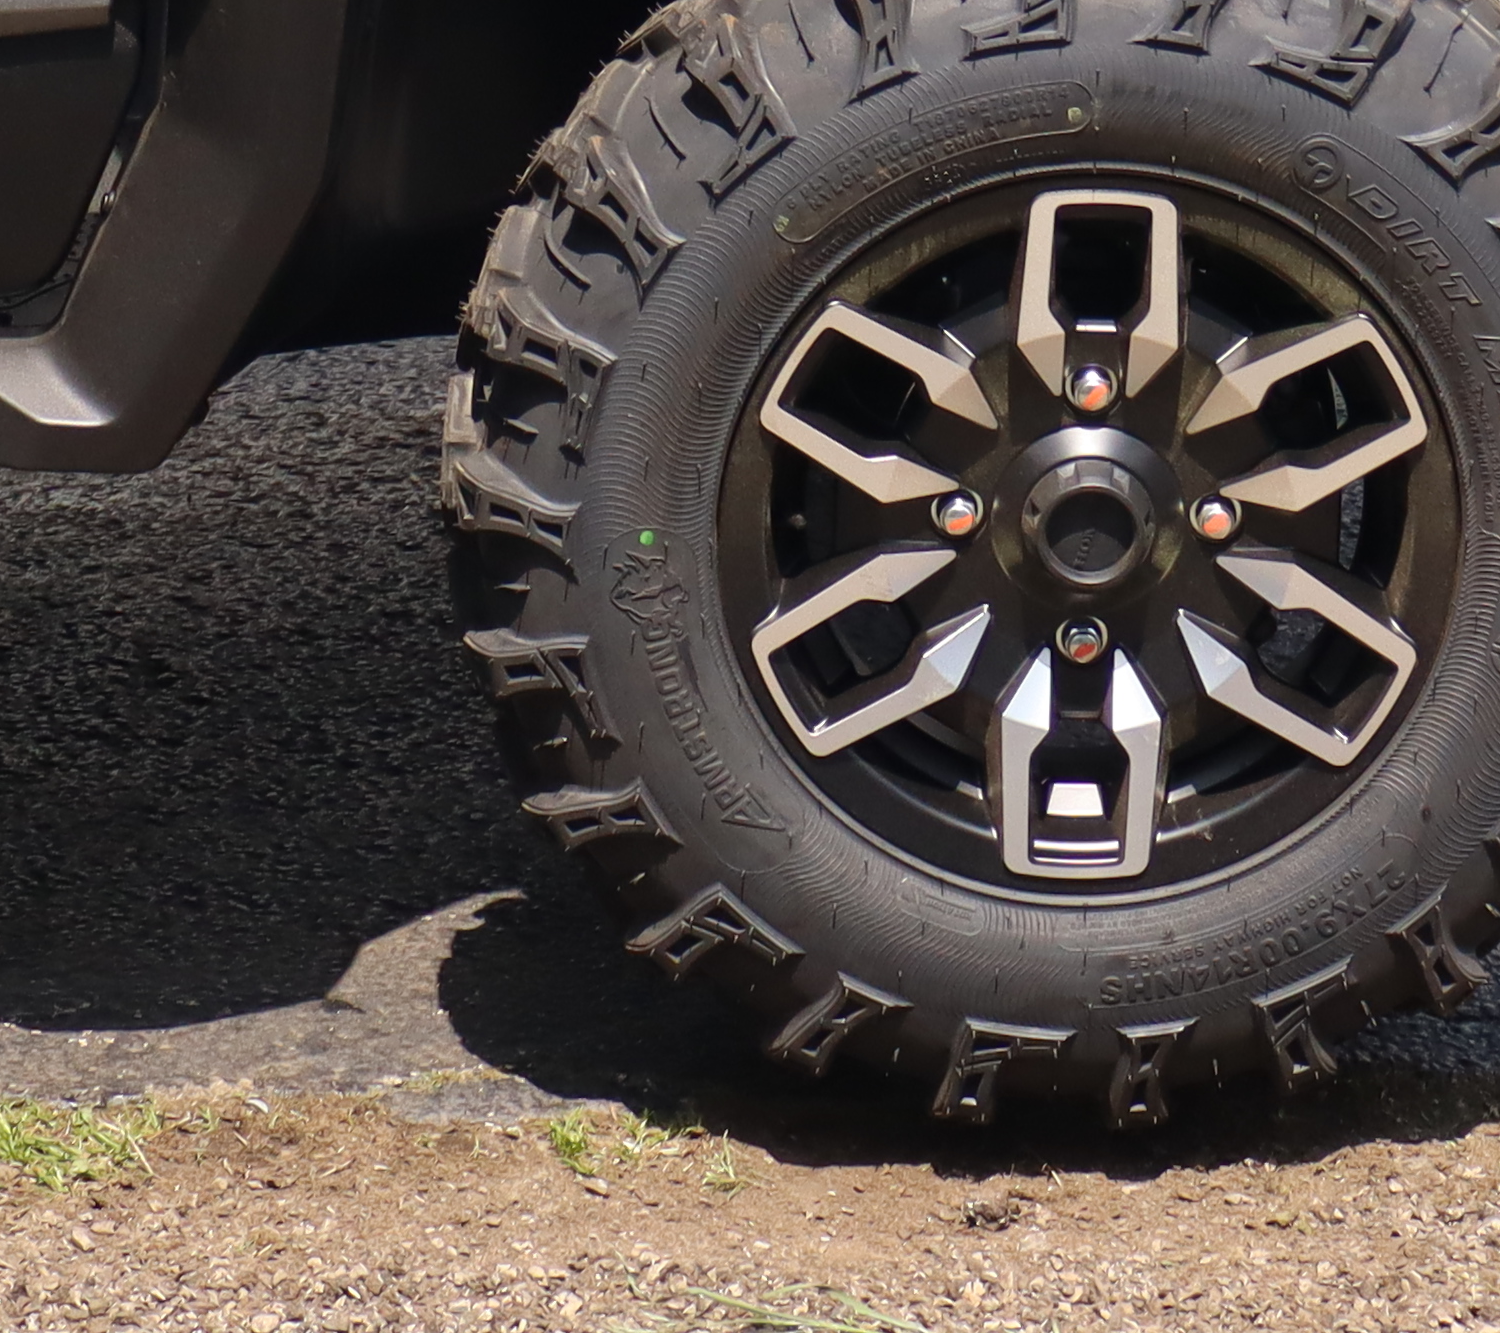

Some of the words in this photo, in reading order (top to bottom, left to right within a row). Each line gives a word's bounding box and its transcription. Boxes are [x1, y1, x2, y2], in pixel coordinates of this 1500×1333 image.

[860, 155, 913, 195] MADE
[914, 145, 938, 166] IN
[940, 124, 1001, 156] CHINA
[1347, 184, 1483, 306] DIRT
[642, 623, 786, 832] ARMSTRONG
